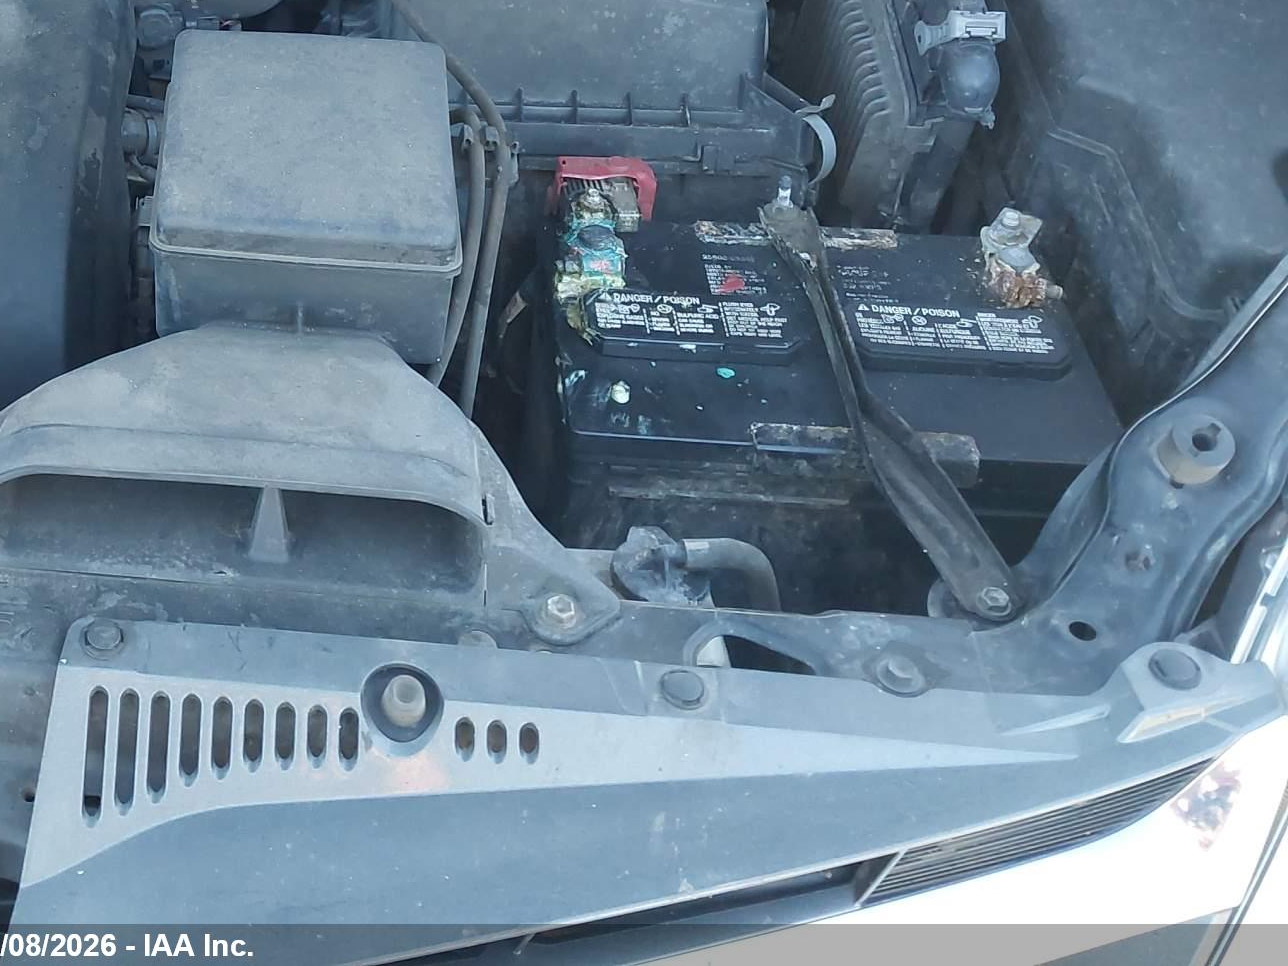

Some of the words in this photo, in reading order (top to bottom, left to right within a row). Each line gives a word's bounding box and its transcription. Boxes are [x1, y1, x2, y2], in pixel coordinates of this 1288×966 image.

[613, 293, 653, 303] DANGER
[663, 296, 700, 305] POISON
[870, 304, 912, 315] DANGER
[921, 308, 960, 318] POISON
